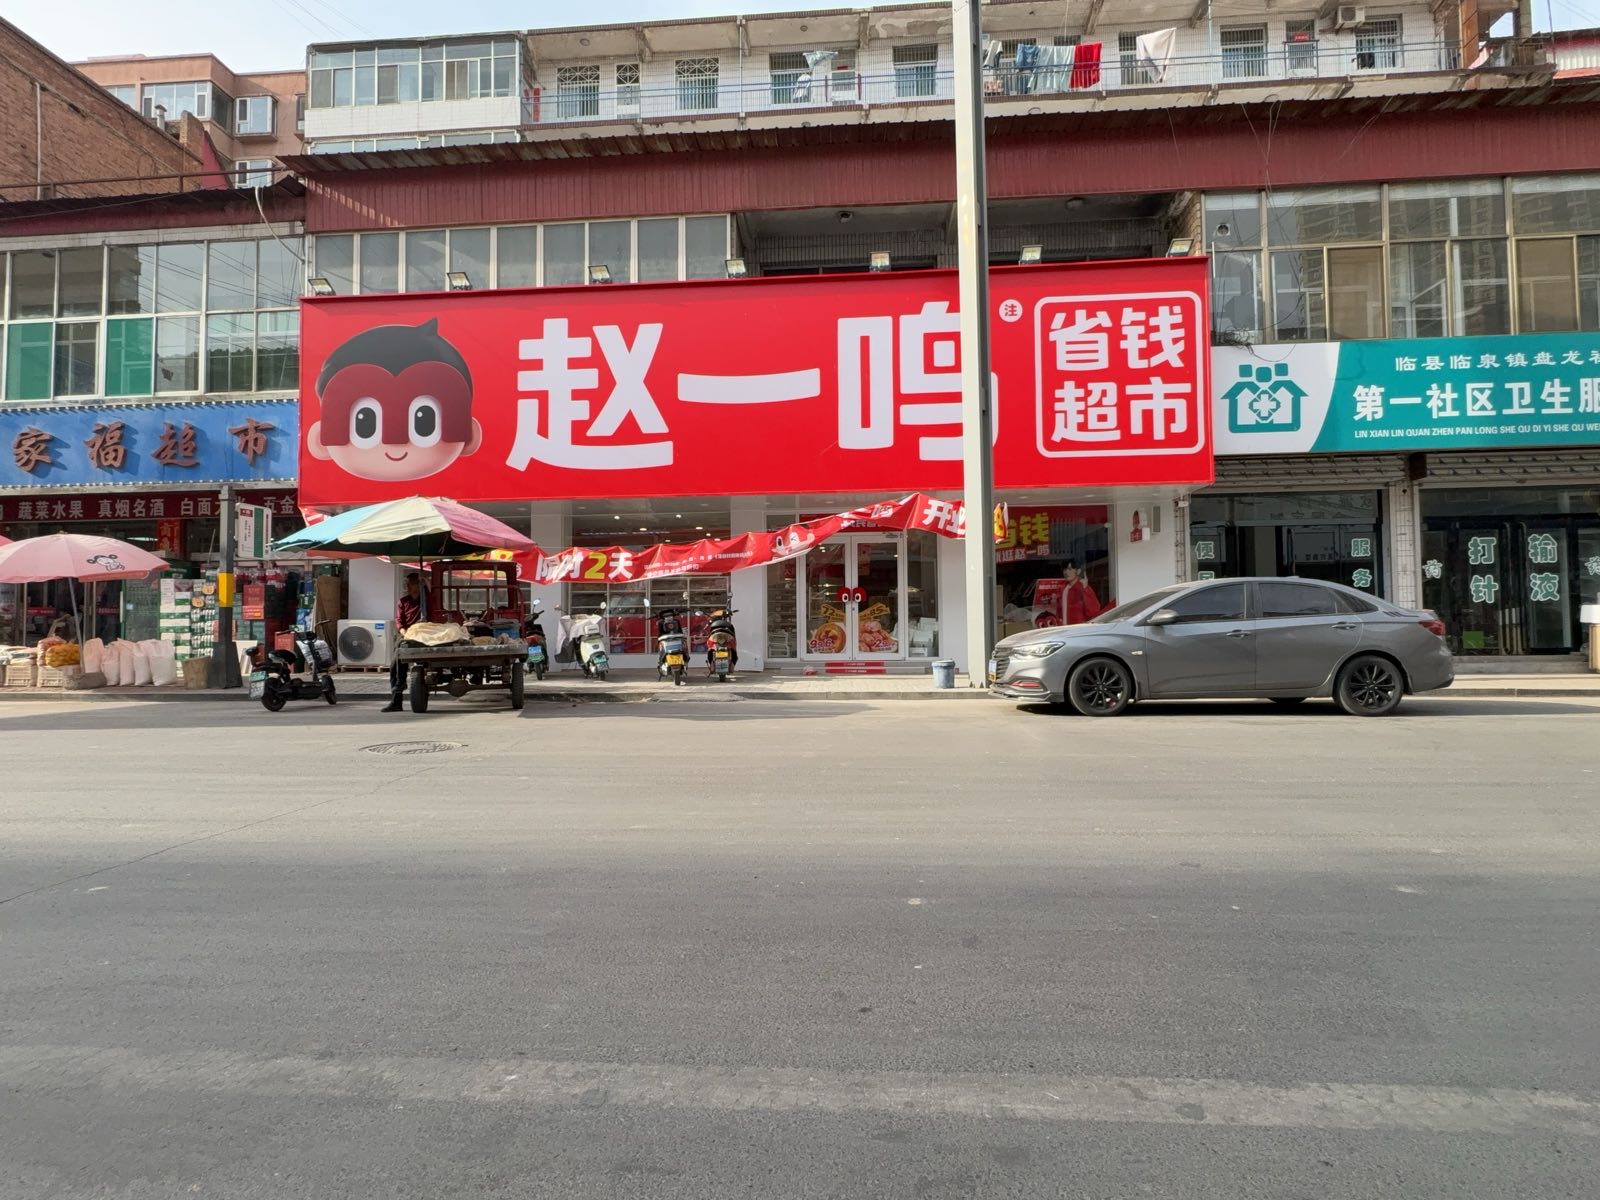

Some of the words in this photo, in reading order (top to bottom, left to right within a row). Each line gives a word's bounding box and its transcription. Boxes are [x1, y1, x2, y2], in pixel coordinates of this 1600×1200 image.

[1049, 306, 1185, 371] 省钱
[505, 302, 998, 471] 赵一鸣
[1051, 376, 1191, 442] 超市
[1353, 377, 1600, 421] 第一社区卫生服
[12, 418, 275, 471] 家福超市
[1355, 430, 1368, 439] LIN
[1369, 429, 1390, 438] XIAN
[1390, 429, 1405, 438] LIN
[1405, 428, 1431, 437] QUAN
[1432, 427, 1454, 436] ZHEN
[1455, 427, 1473, 436] PAN
[1474, 426, 1498, 435] LONG
[1499, 425, 1516, 434] SHE
[1517, 425, 1531, 434] QU
[1532, 424, 1542, 433] DI
[1542, 424, 1552, 433] YI
[1552, 424, 1570, 432] SHE
[1571, 423, 1585, 432] QU
[18, 500, 84, 520] 蔬菜水果
[98, 498, 165, 518] 真烟名酒
[180, 496, 246, 517] 白面
[263, 495, 296, 515] 五金
[535, 551, 633, 581] 限时2天
[1467, 536, 1499, 604] 打针
[1527, 533, 1560, 602] 输液
